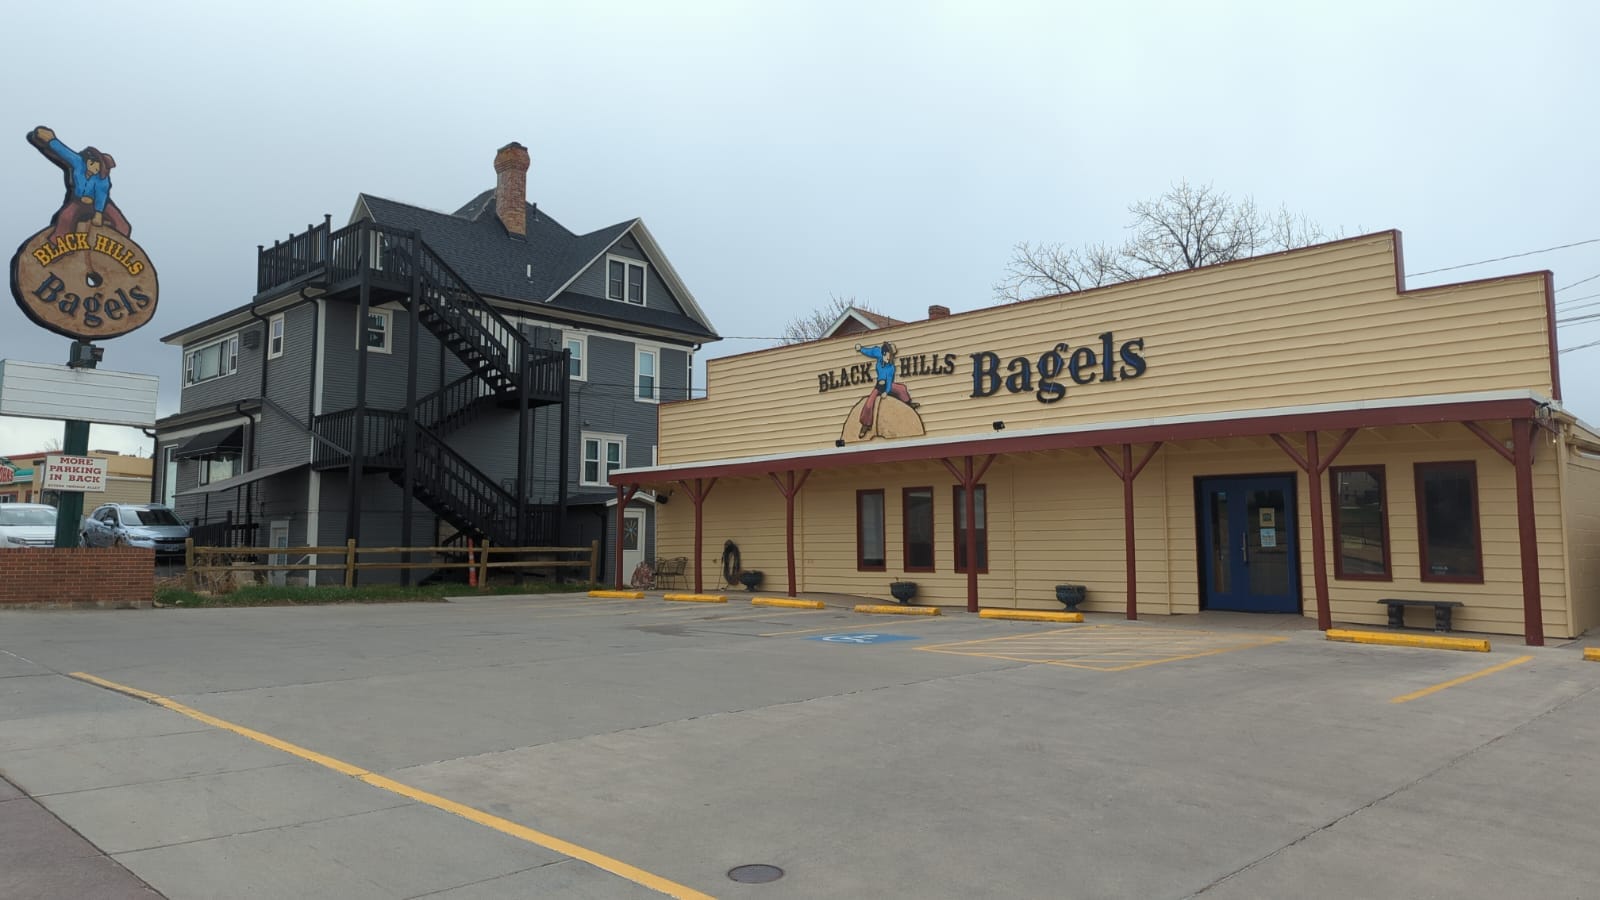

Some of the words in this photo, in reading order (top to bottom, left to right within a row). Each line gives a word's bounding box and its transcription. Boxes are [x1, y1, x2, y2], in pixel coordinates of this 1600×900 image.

[33, 233, 90, 266] BLACK
[95, 234, 144, 275] HILLS
[32, 271, 151, 328] Bagels
[818, 362, 873, 392] BLACK
[899, 353, 956, 377] HILLS
[969, 331, 1147, 403] Bagels
[49, 465, 102, 474] PARKING
[60, 457, 94, 465] MORE
[69, 475, 101, 483] BACK
